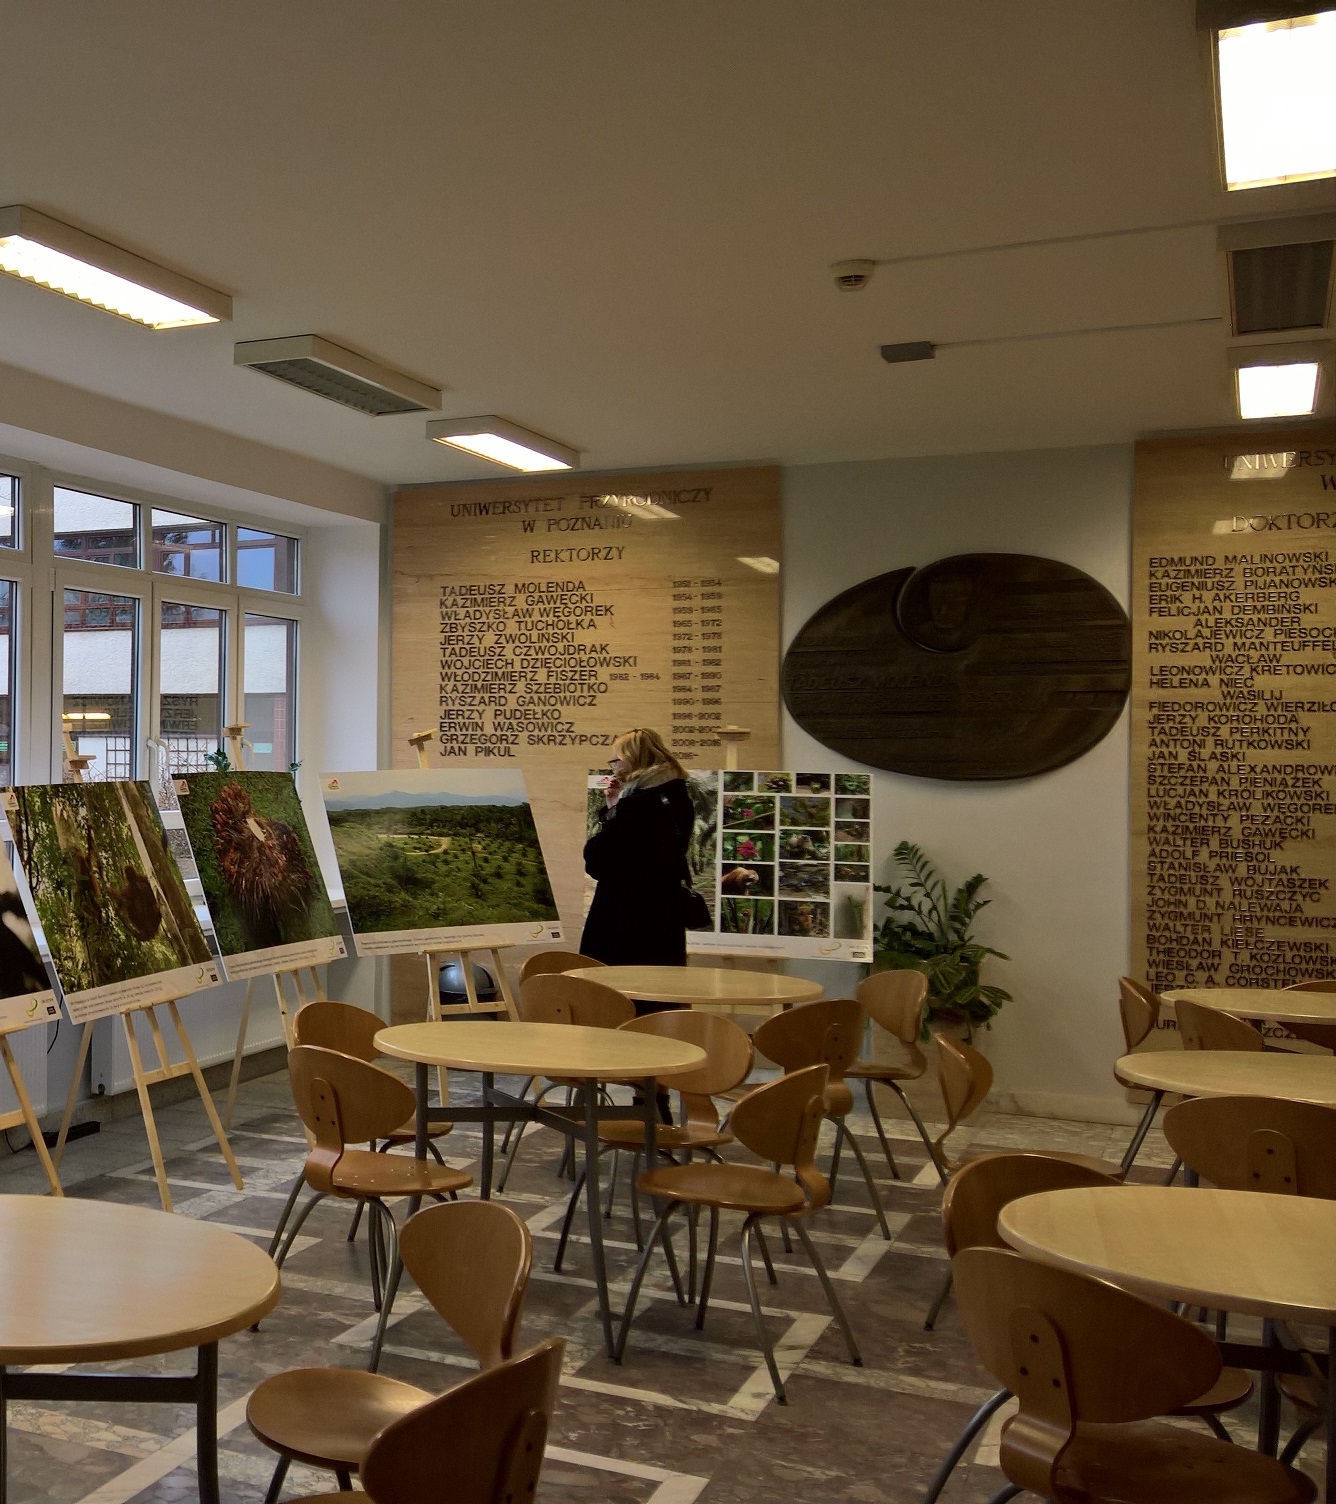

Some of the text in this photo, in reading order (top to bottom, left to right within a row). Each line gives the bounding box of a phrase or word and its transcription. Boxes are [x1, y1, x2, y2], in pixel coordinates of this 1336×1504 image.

[450, 497, 564, 518] UNIWERSYTET
[521, 519, 536, 534] W
[530, 546, 626, 564] REKTORZY
[1149, 552, 1328, 568] EDMUND MALINOWSKI
[1149, 563, 1336, 580] KAZIMIERZ BORATYŃS
[441, 584, 506, 597] TADEUSZ
[514, 581, 586, 594] MOLENDA
[1149, 580, 1236, 592] EUGENIUSZ
[440, 596, 517, 608] KAZIMIERZ
[526, 593, 594, 607] GAWĘCKI
[1149, 590, 1300, 605] ERIK H. AKERBERG
[441, 608, 534, 621] WŁADYSŁAW
[539, 605, 614, 619] WĘGOREK
[1149, 601, 1318, 617] FELICJAN DEMBIŃSKI
[440, 621, 506, 633] ZBYSZKO
[1194, 616, 1301, 629] ALEKSANDER
[440, 634, 485, 646] JERZY
[494, 631, 575, 645] ZWOLIŃSKI
[1149, 627, 1336, 641] NIKOLAJEWICZ PIESOC
[441, 646, 506, 658] TADEUSZ
[513, 644, 610, 657] CZWOJDRAK
[1149, 641, 1224, 653] RYSZARD
[440, 658, 514, 670] WOJCIECH
[520, 656, 638, 670] DZIĘCIOŁOWSKI
[1210, 653, 1282, 665] WACŁAW
[440, 671, 538, 683] WŁODZIMIERZ
[546, 670, 598, 682] FISZER
[1150, 665, 1245, 677] LEONOWICZ
[439, 683, 517, 695] KAZIMIERZ
[524, 682, 608, 694] SZEBIOTKO
[1149, 678, 1211, 689] HELENA
[439, 695, 597, 707] RYSZARD GANOWICZ
[1221, 690, 1283, 701] WASILIJ
[440, 708, 562, 720] JERZY PUDEŁKO
[1149, 701, 1258, 713] FIEDOROWICZ
[1148, 714, 1299, 725] JERZY KOROHODA
[440, 721, 484, 733] ERWIN
[1148, 726, 1311, 738] TADEUSZ PERKITNY
[440, 733, 616, 746] GRZEGORZ SKRZYPCZ
[1148, 738, 1310, 750] ANTONI RUTKOWSKI
[440, 746, 515, 757] JAN PIKUL
[1148, 751, 1178, 762] JAN
[1148, 762, 1336, 776] STEFAN ALEXANDROW
[1148, 775, 1230, 787] SZCZEPAN
[1148, 787, 1329, 801] LUCJAN KRÓLIKOWSKI
[1148, 800, 1252, 812] WŁADYSŁAW
[1148, 812, 1232, 824] WINCENTY
[1148, 824, 1315, 840] KAZIMIERZ GAWĘCKI
[1148, 836, 1284, 850] WALTER BUSHUK
[1148, 849, 1276, 863] ADOLF PRIESOL
[1147, 861, 1300, 876] STANISŁAW BUJAK
[1147, 873, 1330, 890] TADEUSZ WOJTASZEK
[1147, 885, 1321, 903] ZYGMUNT RUSZCZYC
[1147, 898, 1304, 914] JOHN D. NALEWAJA
[1147, 910, 1224, 923] ZYGMUNT
[1147, 922, 1264, 937] WALTER LIESE
[1146, 934, 1329, 954] BOHDAN KIEŁCZEWSKI
[1147, 947, 1222, 960] THEODOR
[1232, 951, 1244, 962] T.
[1147, 959, 1221, 972] WIESŁAW
[1146, 971, 1304, 989] LEO C. A. CORSTE
